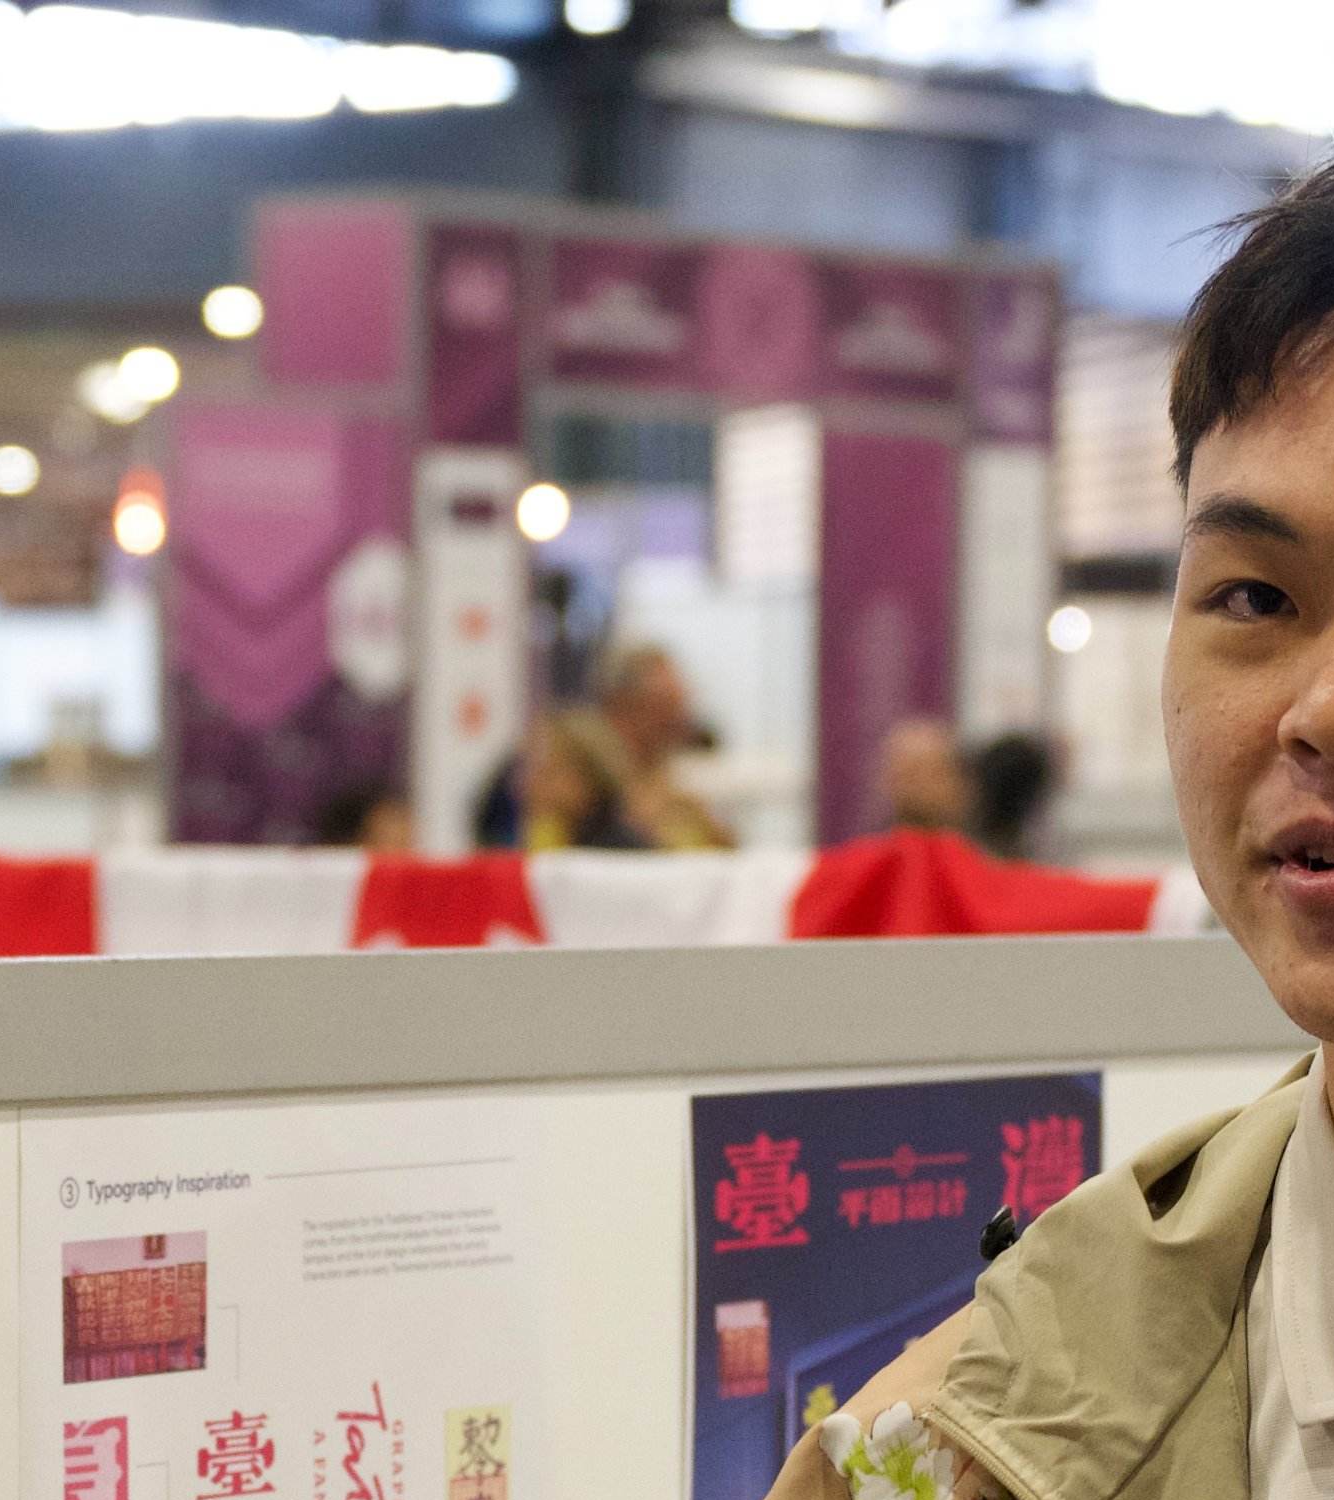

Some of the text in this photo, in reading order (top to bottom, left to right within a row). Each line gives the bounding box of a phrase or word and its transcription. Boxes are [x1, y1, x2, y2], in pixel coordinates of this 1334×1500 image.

[86, 1175, 173, 1205] Typography
[177, 1172, 251, 1195] Inspiration
[714, 1131, 809, 1252] 臺
[313, 1429, 327, 1446] A
